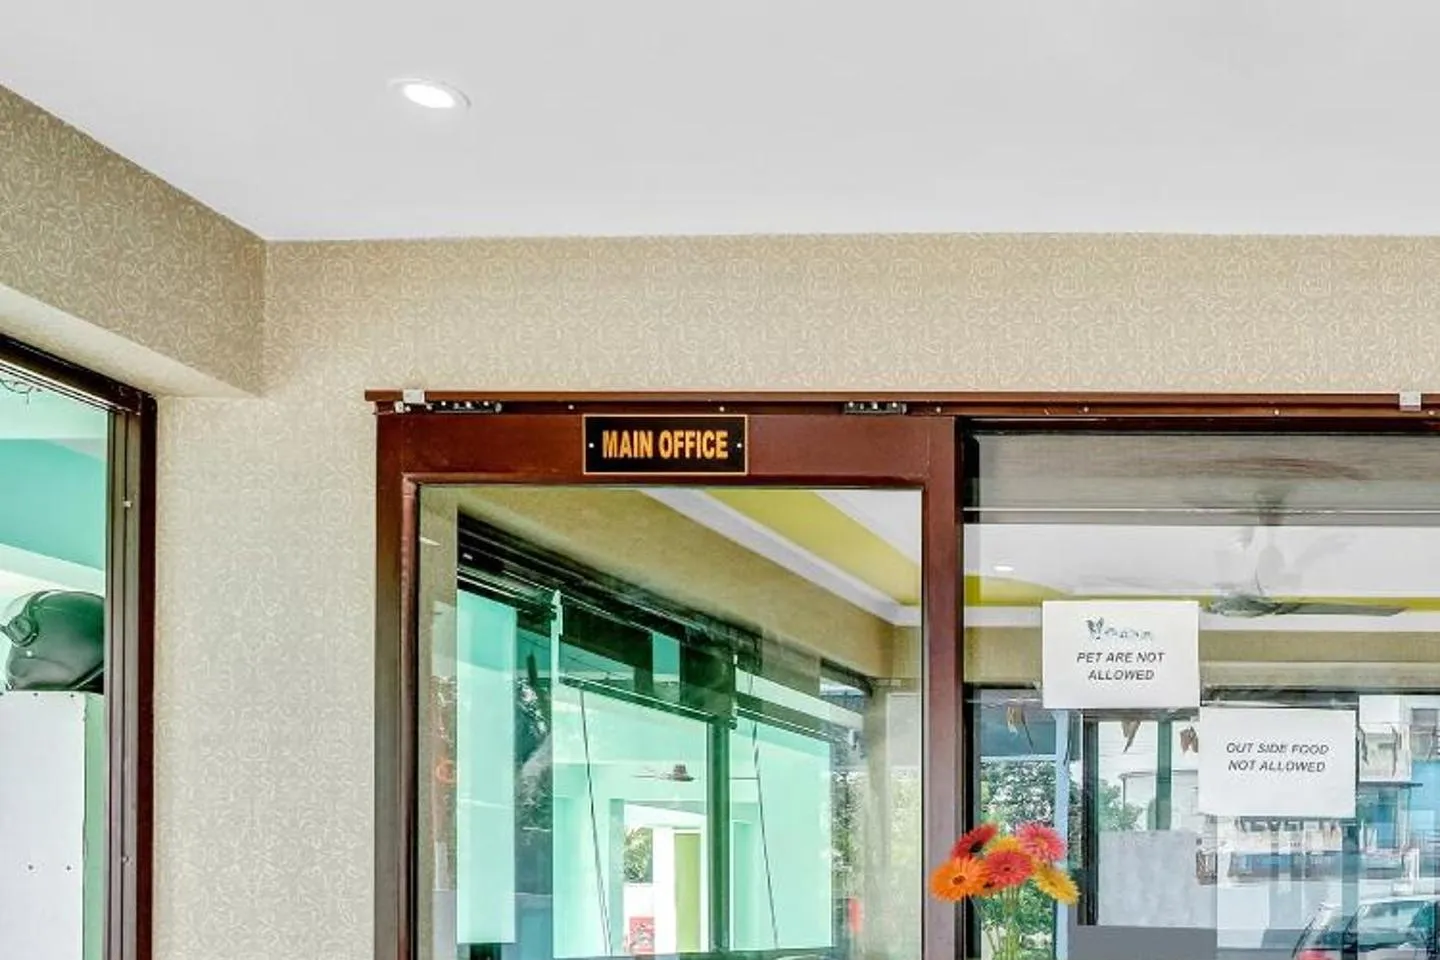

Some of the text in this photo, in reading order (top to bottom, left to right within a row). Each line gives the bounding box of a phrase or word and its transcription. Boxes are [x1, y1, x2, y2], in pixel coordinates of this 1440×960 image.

[602, 429, 729, 459] MAIN OFFICE
[1076, 652, 1166, 663] PET ARE NOT
[1088, 669, 1155, 681] ALLOWED
[1226, 742, 1330, 755] OUT SIDE FOOD
[1228, 760, 1326, 773] NOT ALLOWED
